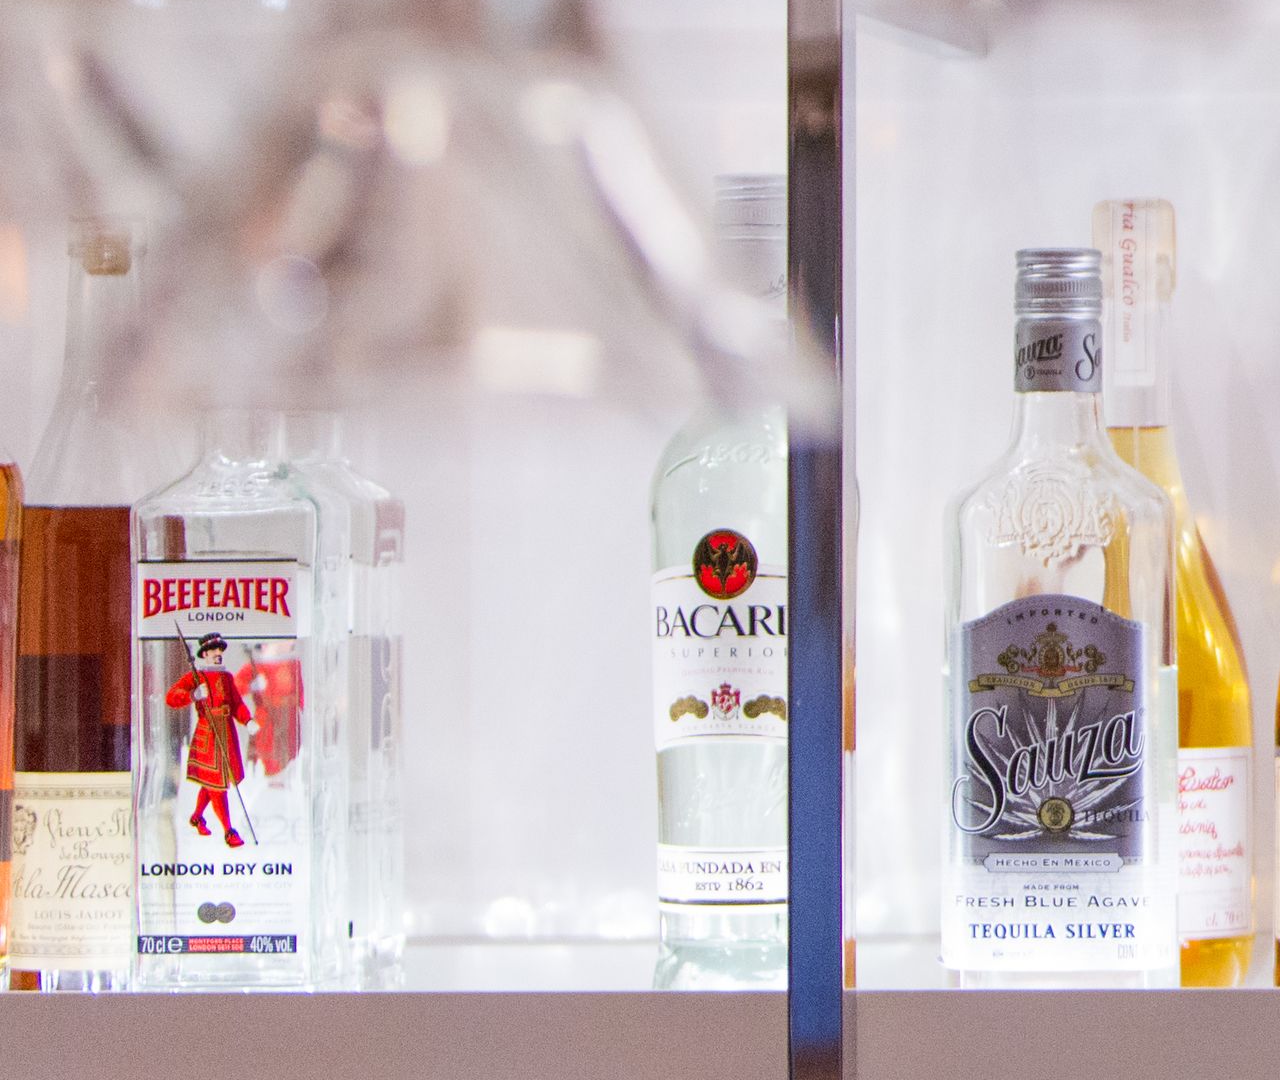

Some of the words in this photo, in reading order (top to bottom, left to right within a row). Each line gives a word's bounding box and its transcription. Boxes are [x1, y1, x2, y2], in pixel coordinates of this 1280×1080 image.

[143, 577, 291, 619] BEEFEATER
[188, 612, 244, 621] LONDON
[1007, 608, 1098, 624] IMPORTED
[953, 705, 1146, 833] Sauza
[141, 863, 214, 876] LONDON
[223, 863, 257, 875] DRY
[263, 863, 292, 875] GIN
[728, 878, 764, 891] 1862
[955, 896, 1015, 907] FRESH
[1024, 895, 1077, 907] BLUE
[1087, 895, 1150, 907] AGAVE
[969, 923, 1055, 939] TEQUILA
[1066, 923, 1136, 938] SILVER
[141, 937, 154, 953] 70
[156, 937, 166, 952] cl
[250, 936, 273, 952] 40%
[275, 936, 293, 952] vol.
